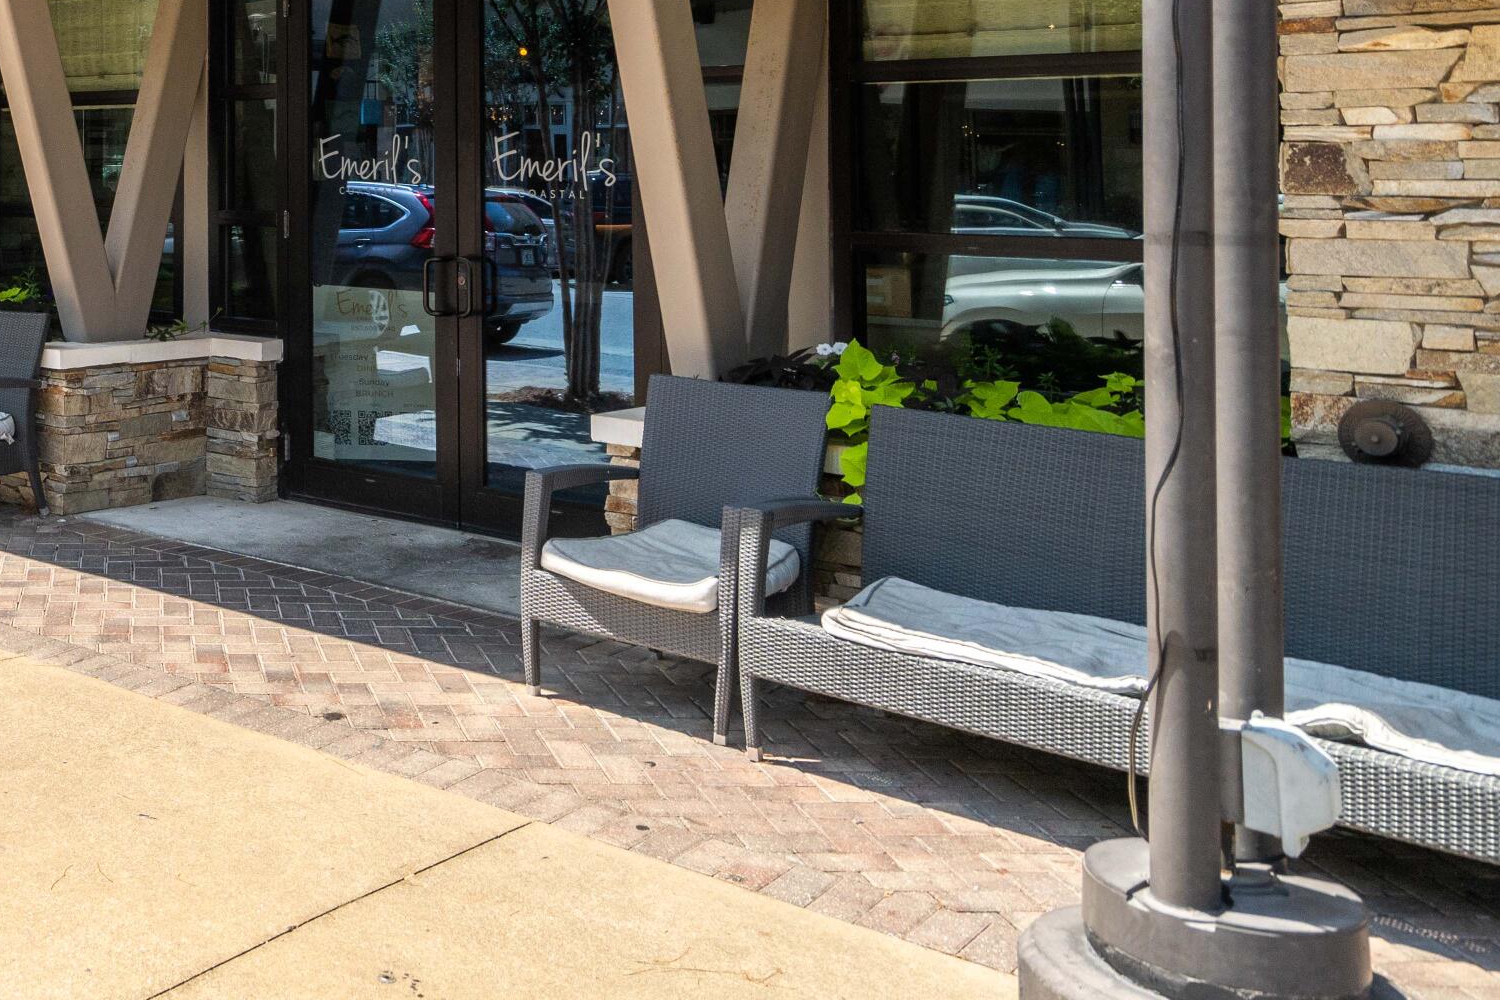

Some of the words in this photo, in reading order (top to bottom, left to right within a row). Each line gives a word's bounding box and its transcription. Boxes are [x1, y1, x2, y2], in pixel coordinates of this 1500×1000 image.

[318, 133, 422, 185] Emeril's
[492, 130, 617, 192] Emeril's
[355, 390, 395, 398] BRUNCH
[358, 378, 389, 387] Sunday
